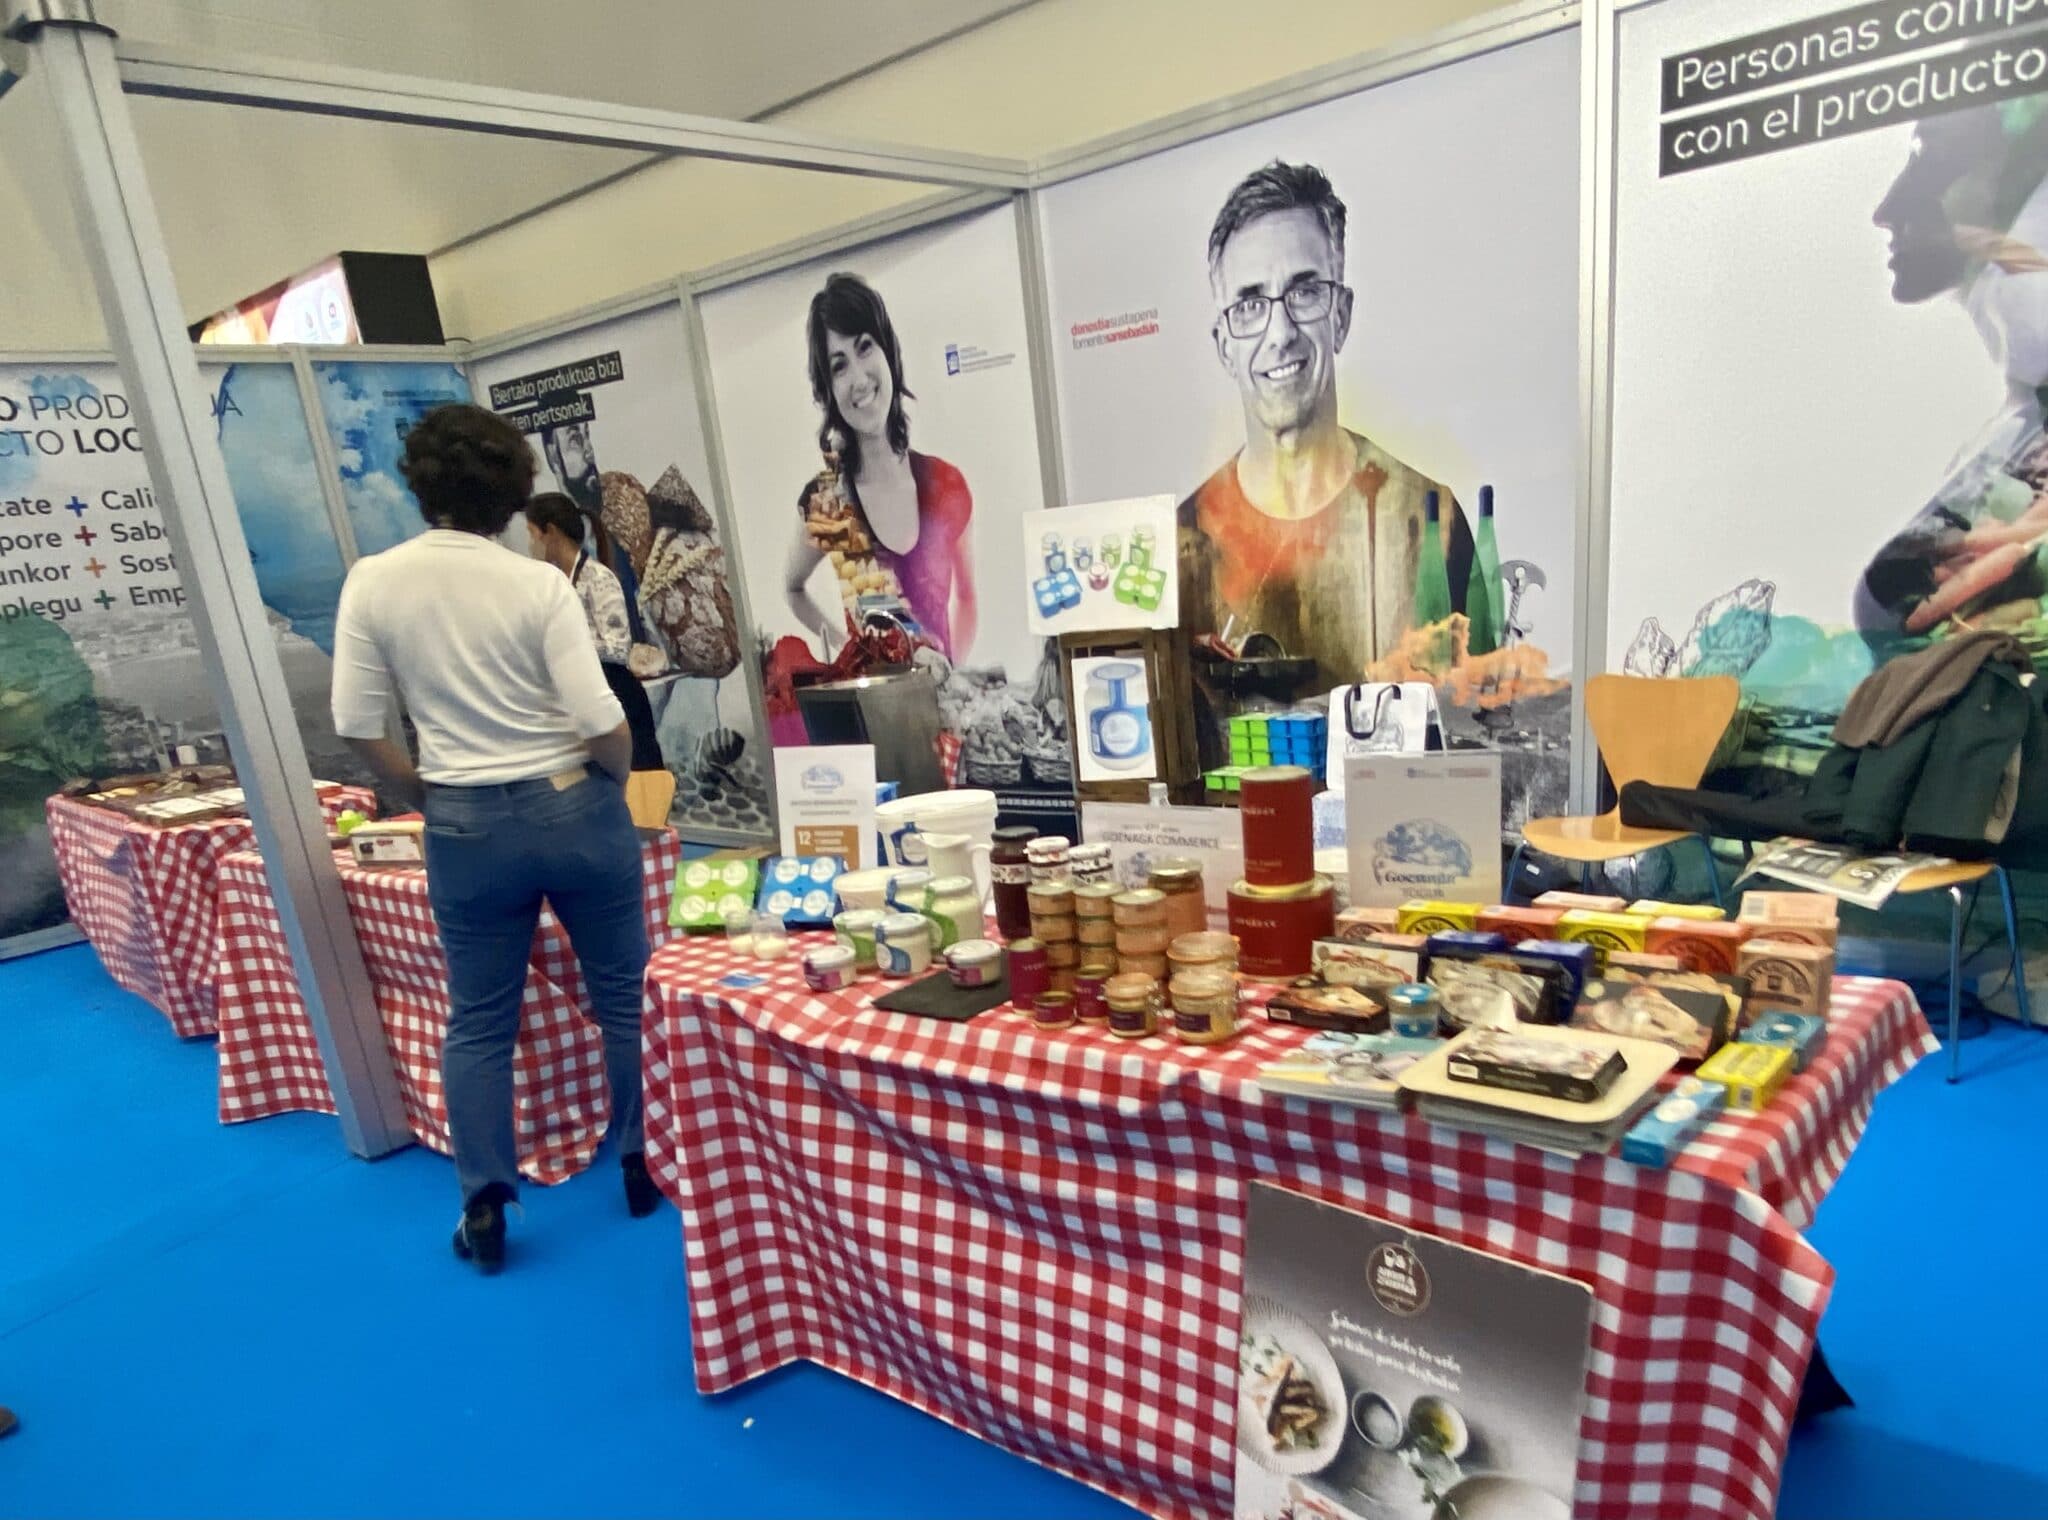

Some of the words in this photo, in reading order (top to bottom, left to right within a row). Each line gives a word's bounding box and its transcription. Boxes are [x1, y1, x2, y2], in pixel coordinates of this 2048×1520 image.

[1677, 18, 1880, 98] Personas
[1895, 0, 2048, 40] comp
[1673, 117, 1749, 159] con
[1763, 94, 1799, 139] el
[1817, 48, 2046, 137] producto
[492, 381, 535, 404] Bertako
[537, 366, 596, 398] produktua
[596, 354, 620, 378] bizi
[101, 487, 158, 510] Cali
